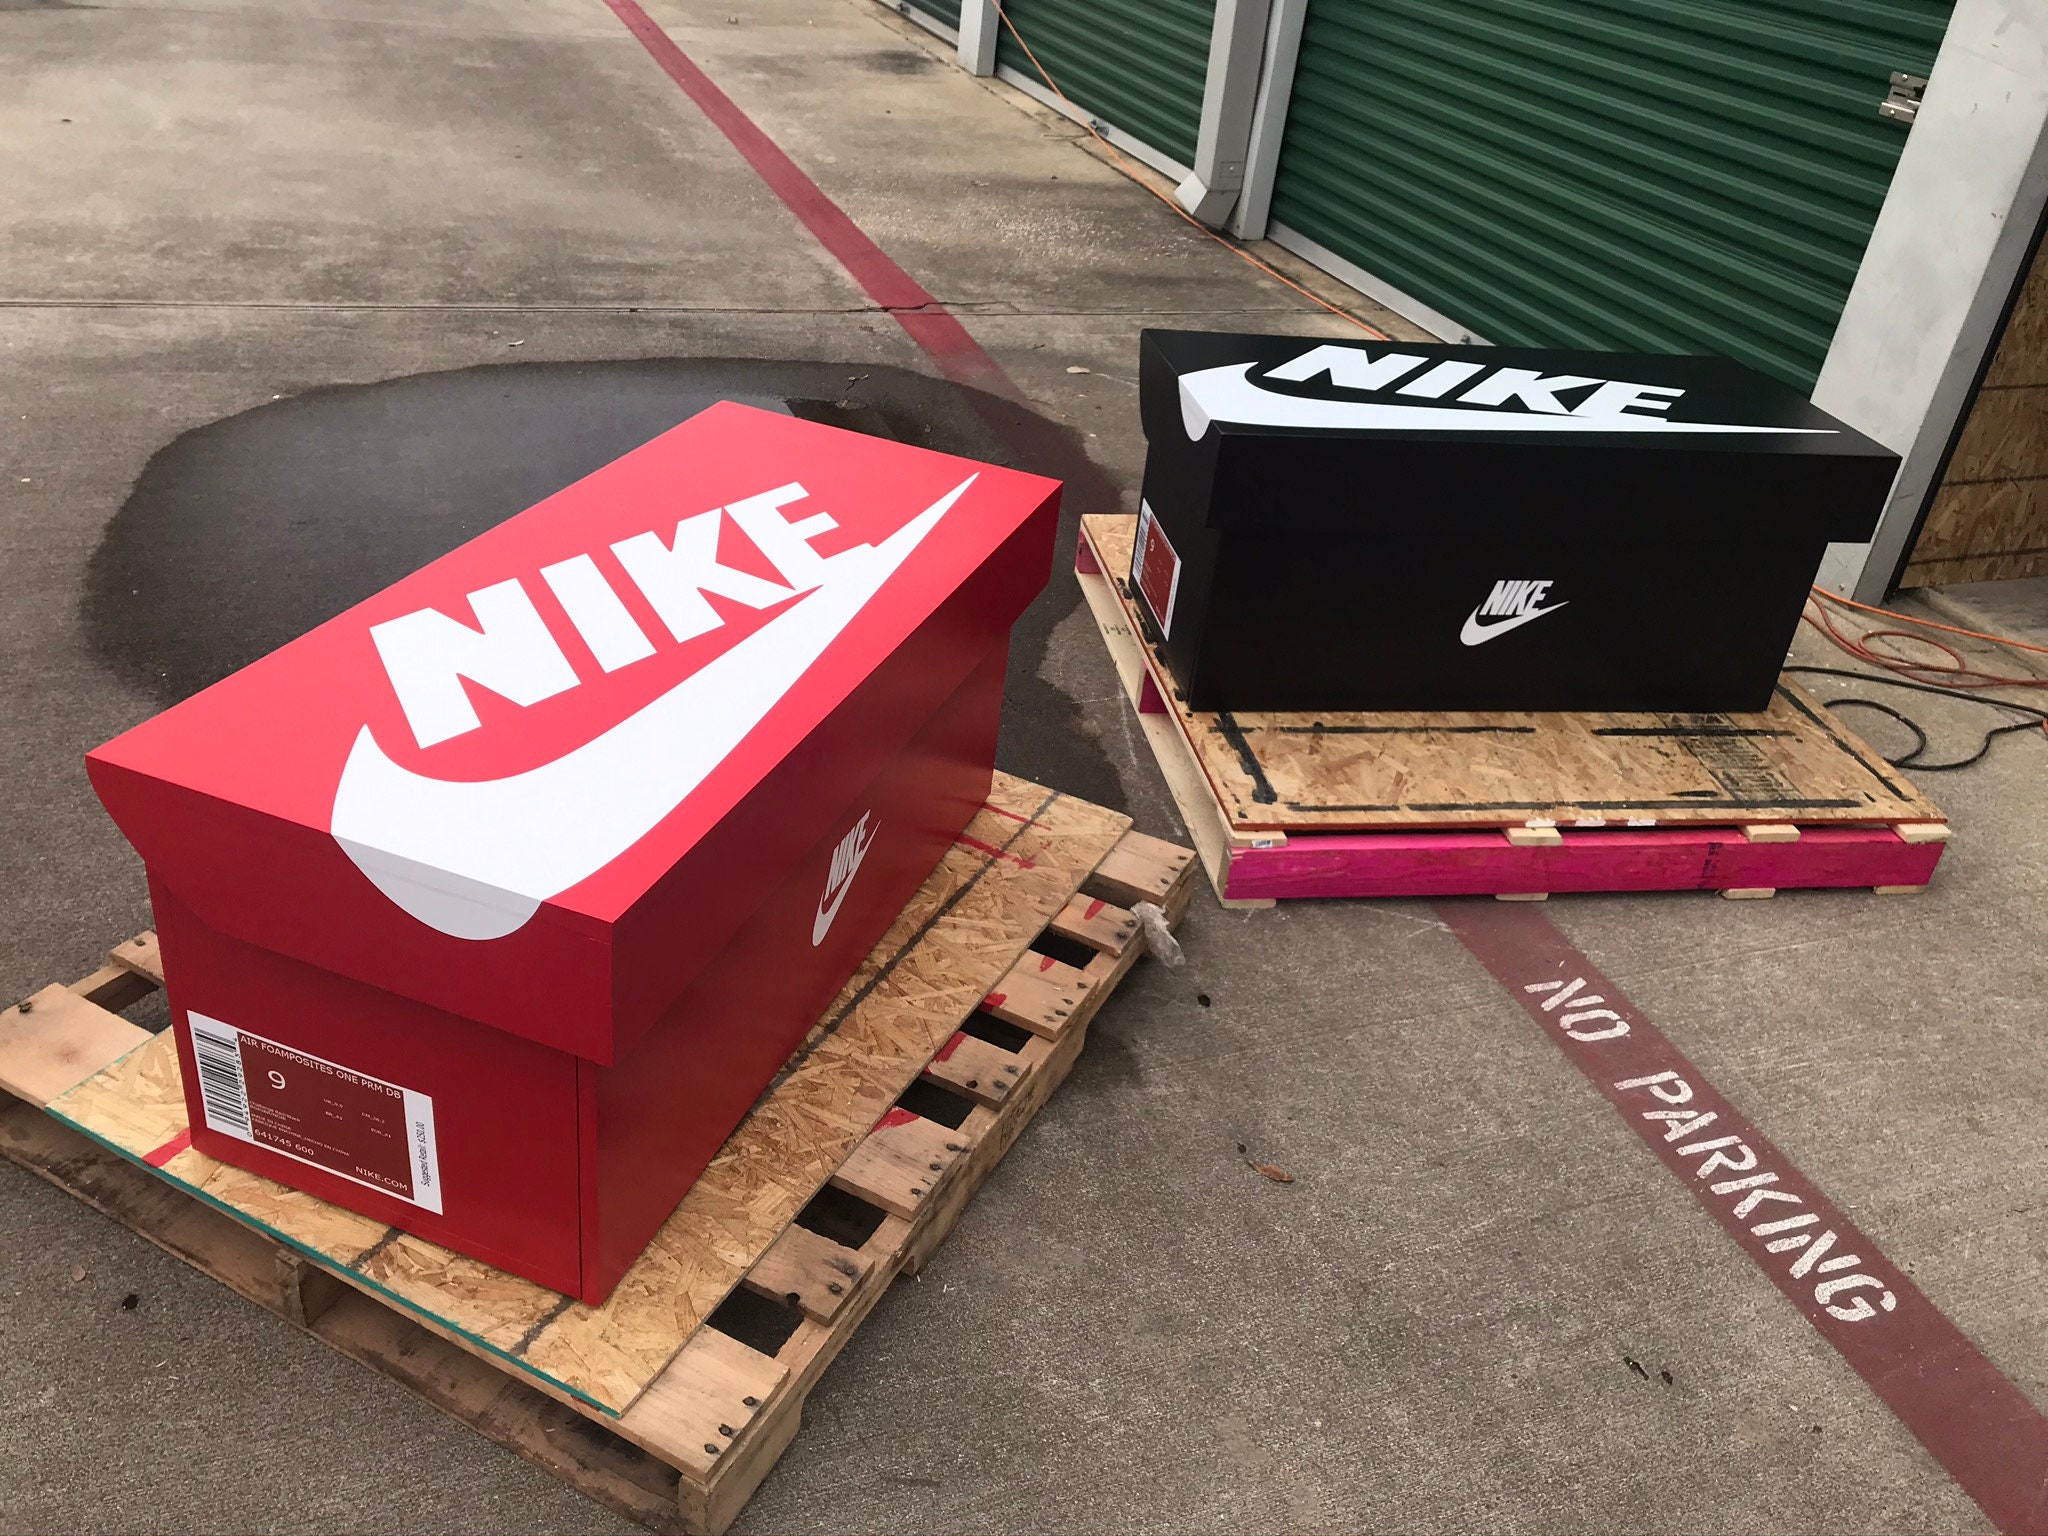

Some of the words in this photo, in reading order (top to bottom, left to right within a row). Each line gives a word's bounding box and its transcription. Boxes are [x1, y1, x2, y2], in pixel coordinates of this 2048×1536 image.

[1262, 344, 1686, 423] NIKE
[369, 481, 873, 750] NIKE
[1479, 580, 1554, 616] NIKE
[823, 808, 871, 902] NIKE
[240, 1035, 259, 1048] AIR
[261, 1042, 333, 1075] FOAMPOSITES
[336, 1070, 358, 1085] ONE
[361, 1078, 383, 1093] PRM
[385, 1087, 401, 1099] DB
[268, 1070, 286, 1090] 9
[254, 1128, 292, 1148] 641745
[295, 1143, 315, 1156] 600
[1523, 977, 1631, 1042] NO
[1613, 1070, 1897, 1322] PARKING
[355, 1165, 408, 1191] NIKE.COM
